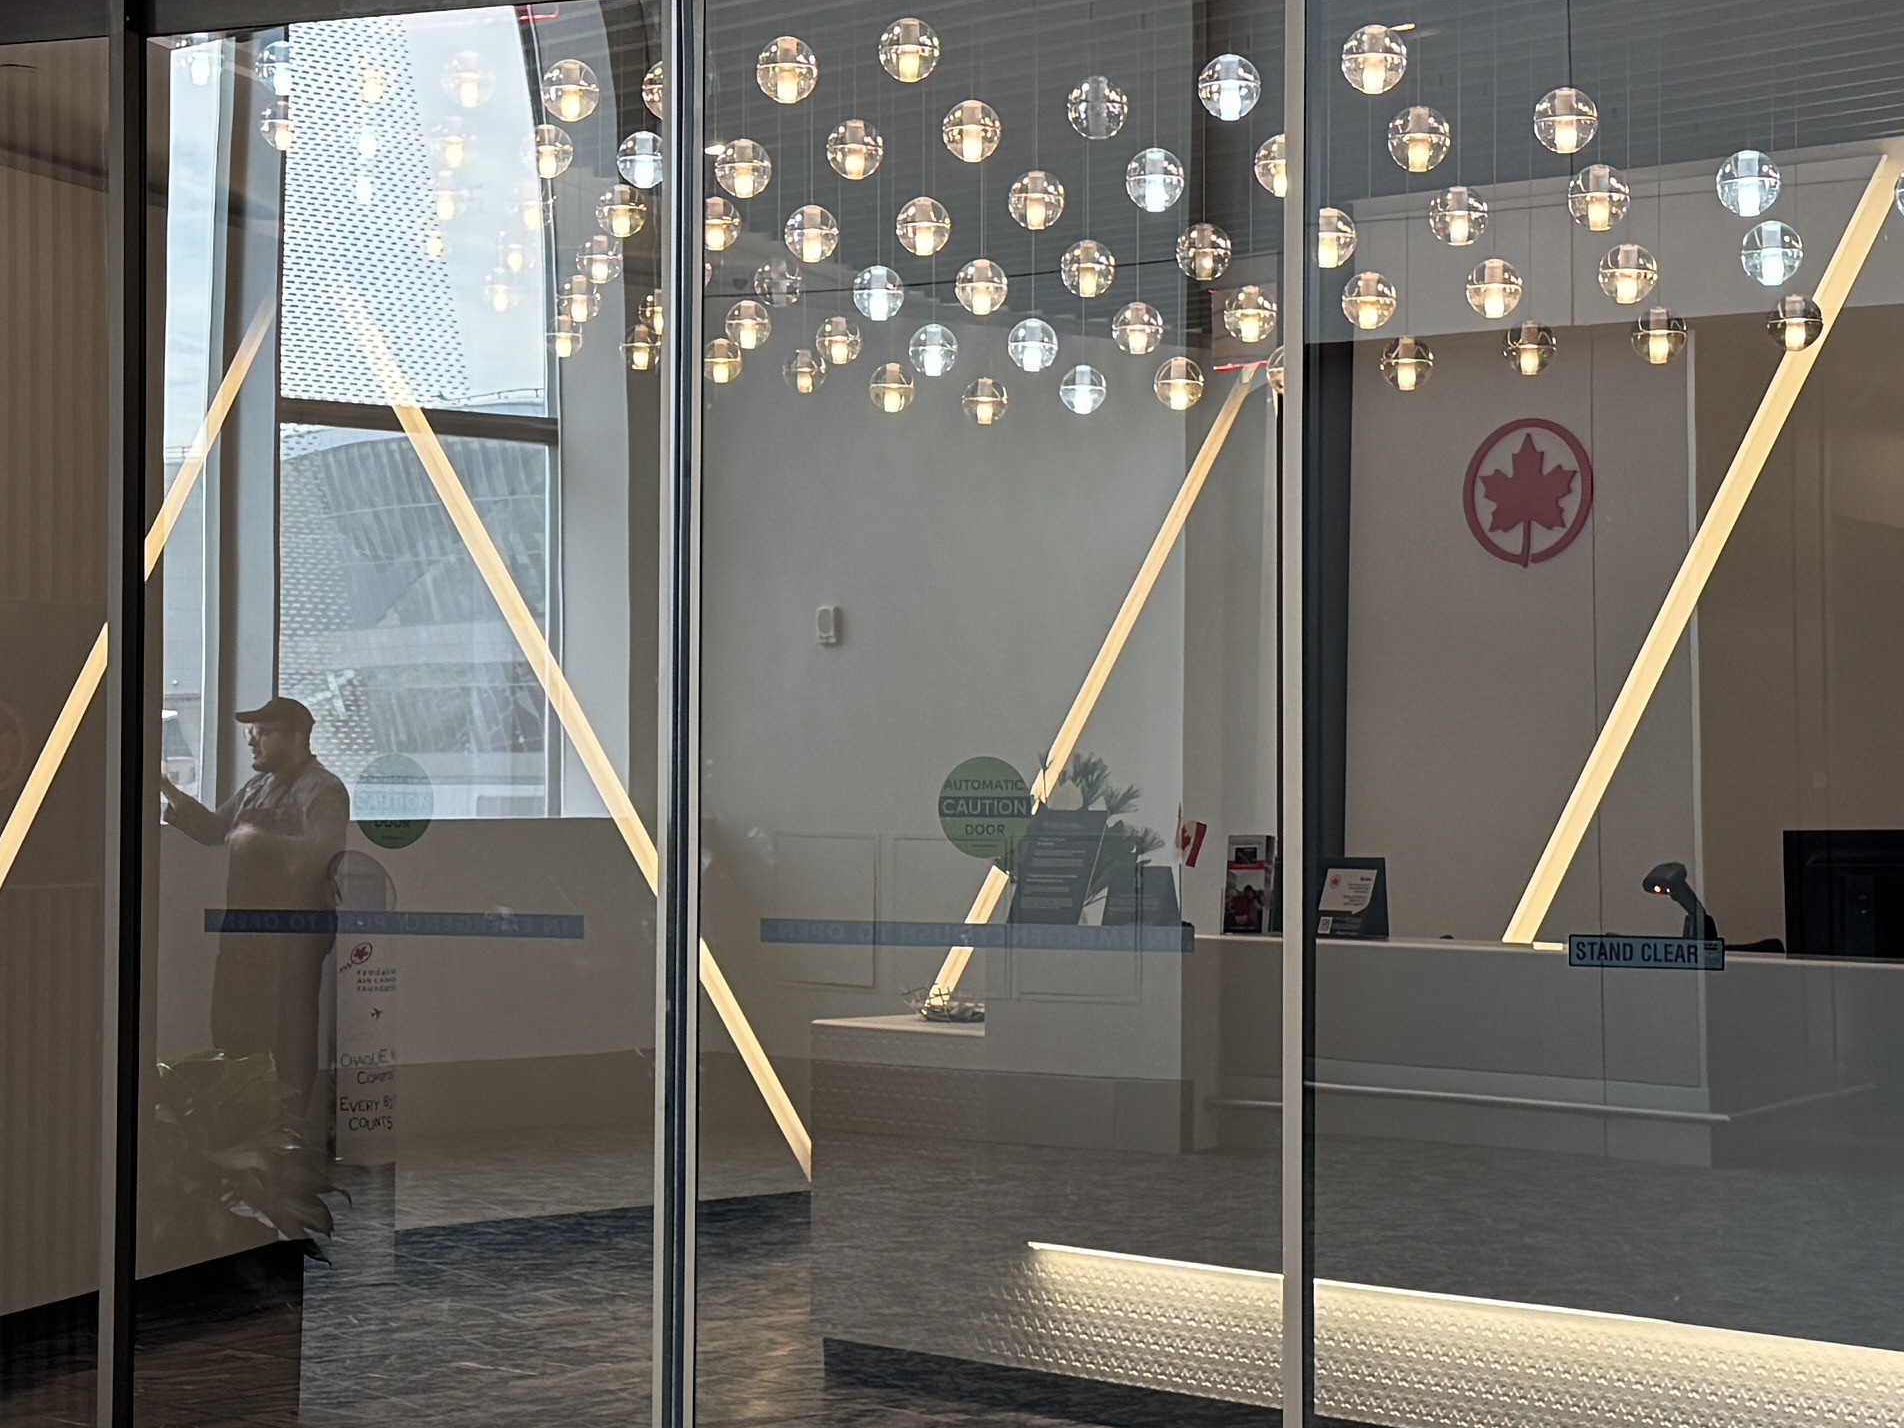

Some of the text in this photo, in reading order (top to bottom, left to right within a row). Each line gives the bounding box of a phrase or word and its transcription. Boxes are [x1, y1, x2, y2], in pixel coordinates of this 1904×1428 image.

[945, 779, 1026, 791] AUTOMATIC
[942, 799, 1026, 815] CAUTION
[965, 824, 1005, 835] DOOR
[1576, 942, 1633, 961] STAND
[1641, 943, 1698, 964] CLEAR
[340, 1097, 380, 1112] EVERY
[349, 1116, 393, 1131] COUNTS
